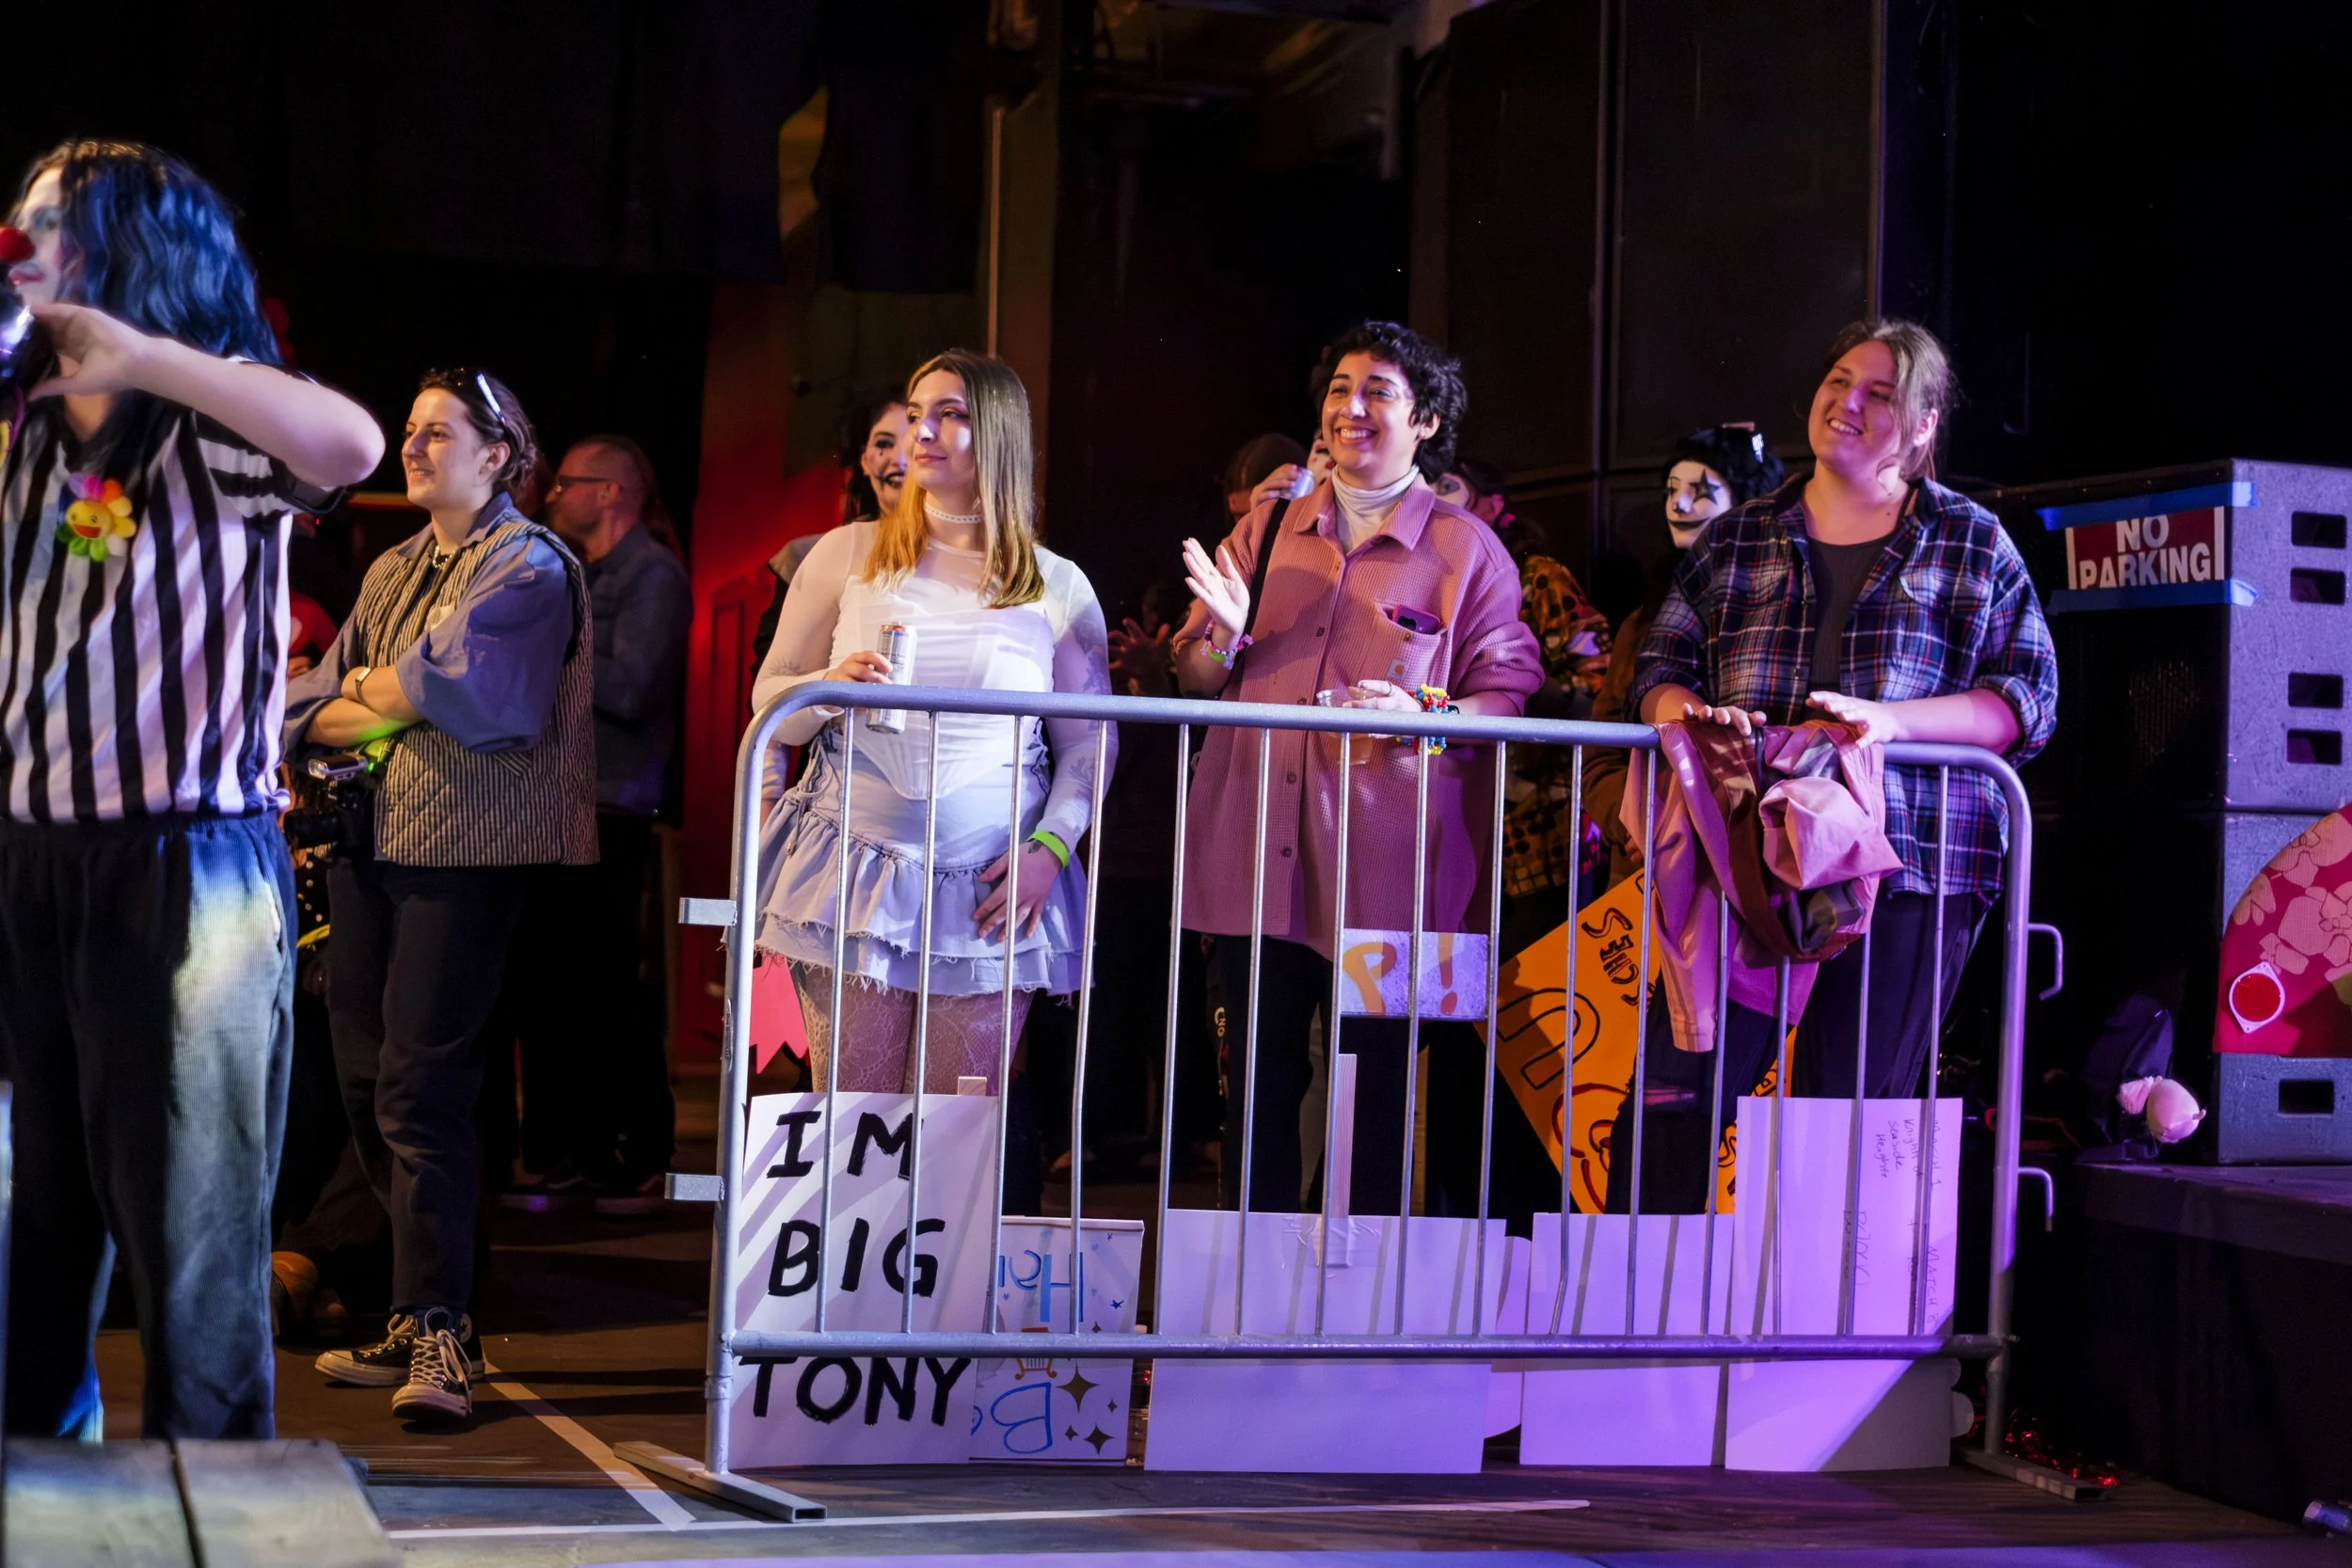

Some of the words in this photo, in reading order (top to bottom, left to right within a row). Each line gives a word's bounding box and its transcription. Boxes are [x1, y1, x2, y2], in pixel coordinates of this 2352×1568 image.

[2116, 515, 2169, 553] NO
[2079, 542, 2211, 590] PARKING
[768, 1217, 946, 1298] BIG
[739, 1356, 972, 1427] TONY
